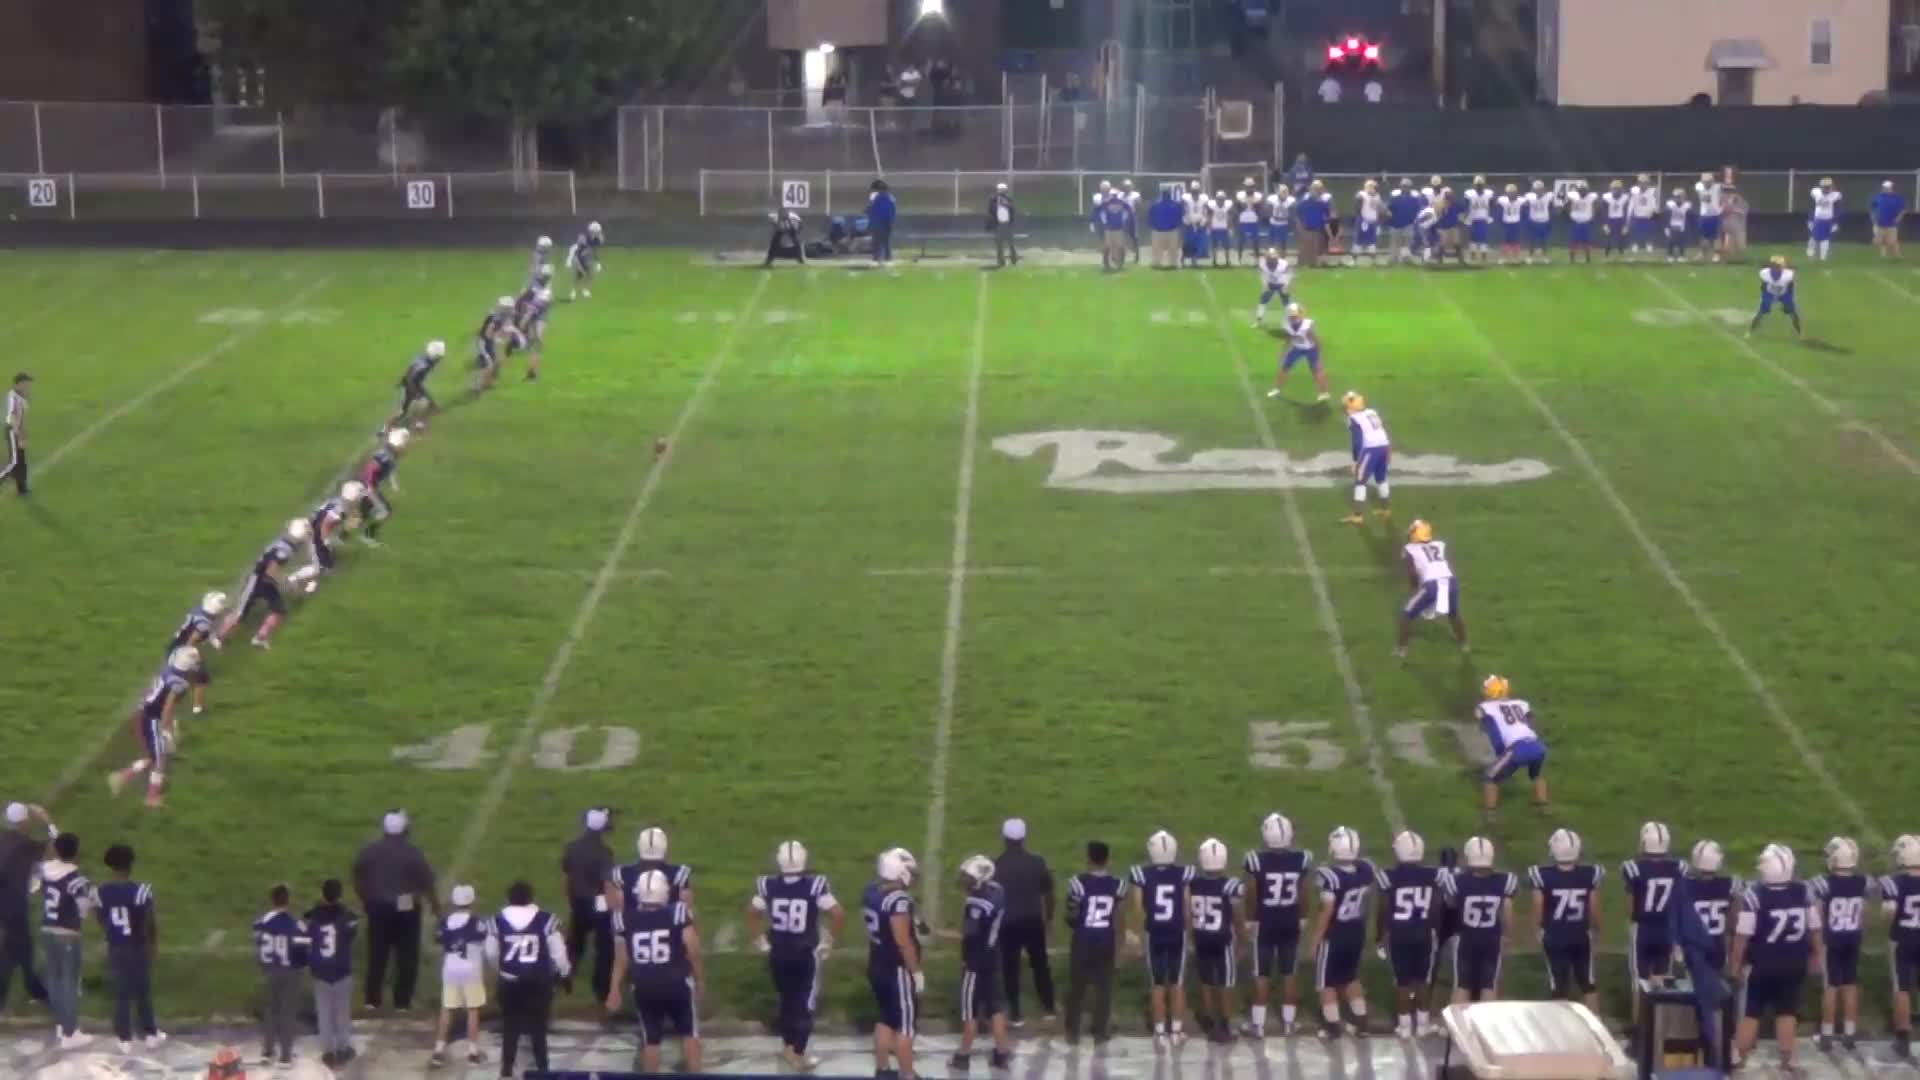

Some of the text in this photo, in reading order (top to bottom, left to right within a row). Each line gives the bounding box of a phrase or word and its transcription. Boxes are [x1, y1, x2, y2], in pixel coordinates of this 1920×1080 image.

[31, 182, 54, 204] 20
[409, 182, 433, 205] 30
[785, 183, 806, 205] 40
[1421, 544, 1443, 563] 12
[1499, 703, 1525, 726] 80
[391, 723, 641, 770] 40
[1250, 721, 1494, 769] 50
[44, 886, 61, 920] 2
[1154, 885, 1175, 921] 5
[1263, 873, 1300, 906] 33
[1394, 887, 1432, 920] 54
[1552, 888, 1587, 921] 75
[1645, 878, 1673, 912] 17
[111, 906, 132, 936] 4
[772, 899, 808, 933] 58
[864, 909, 881, 945] 2
[1085, 895, 1114, 928] 12
[1190, 895, 1222, 930] 95
[1463, 895, 1500, 928] 63
[1766, 907, 1806, 943] 73
[1829, 897, 1864, 931] 80
[260, 934, 290, 966] 24
[320, 924, 336, 958] 3
[504, 934, 539, 964] 70
[632, 929, 671, 964] 66
